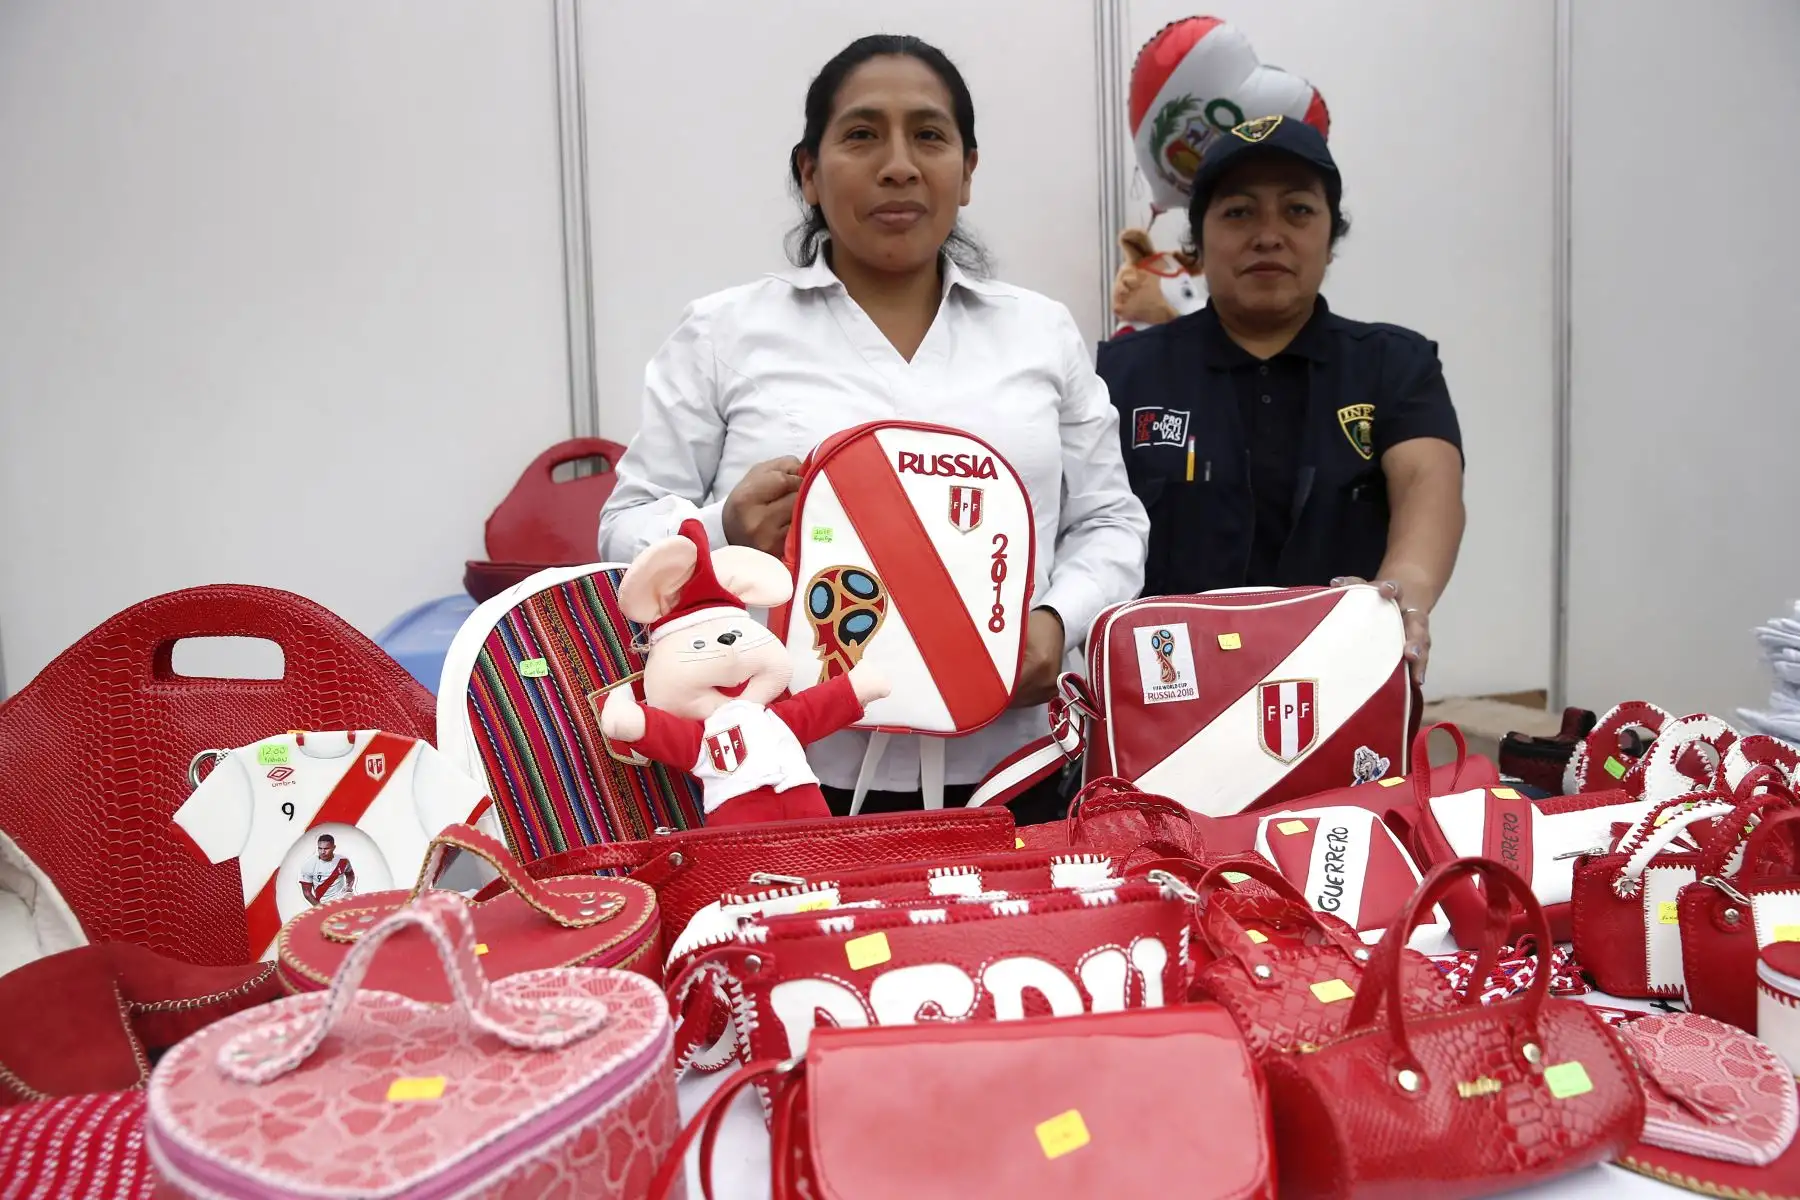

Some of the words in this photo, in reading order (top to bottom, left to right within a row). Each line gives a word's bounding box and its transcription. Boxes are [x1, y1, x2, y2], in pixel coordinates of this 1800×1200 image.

[1163, 414, 1182, 425] PRO
[1161, 430, 1181, 441] VAS
[899, 451, 999, 480] RUSSIA
[953, 501, 978, 512] FPF
[988, 533, 1009, 633] 2018
[1148, 690, 1176, 701] RUSSIA
[1177, 687, 1195, 698] 2018
[1267, 702, 1310, 721] FPF
[714, 740, 740, 758] FPF
[281, 802, 295, 822] 9
[1317, 826, 1349, 912] GUERRERO
